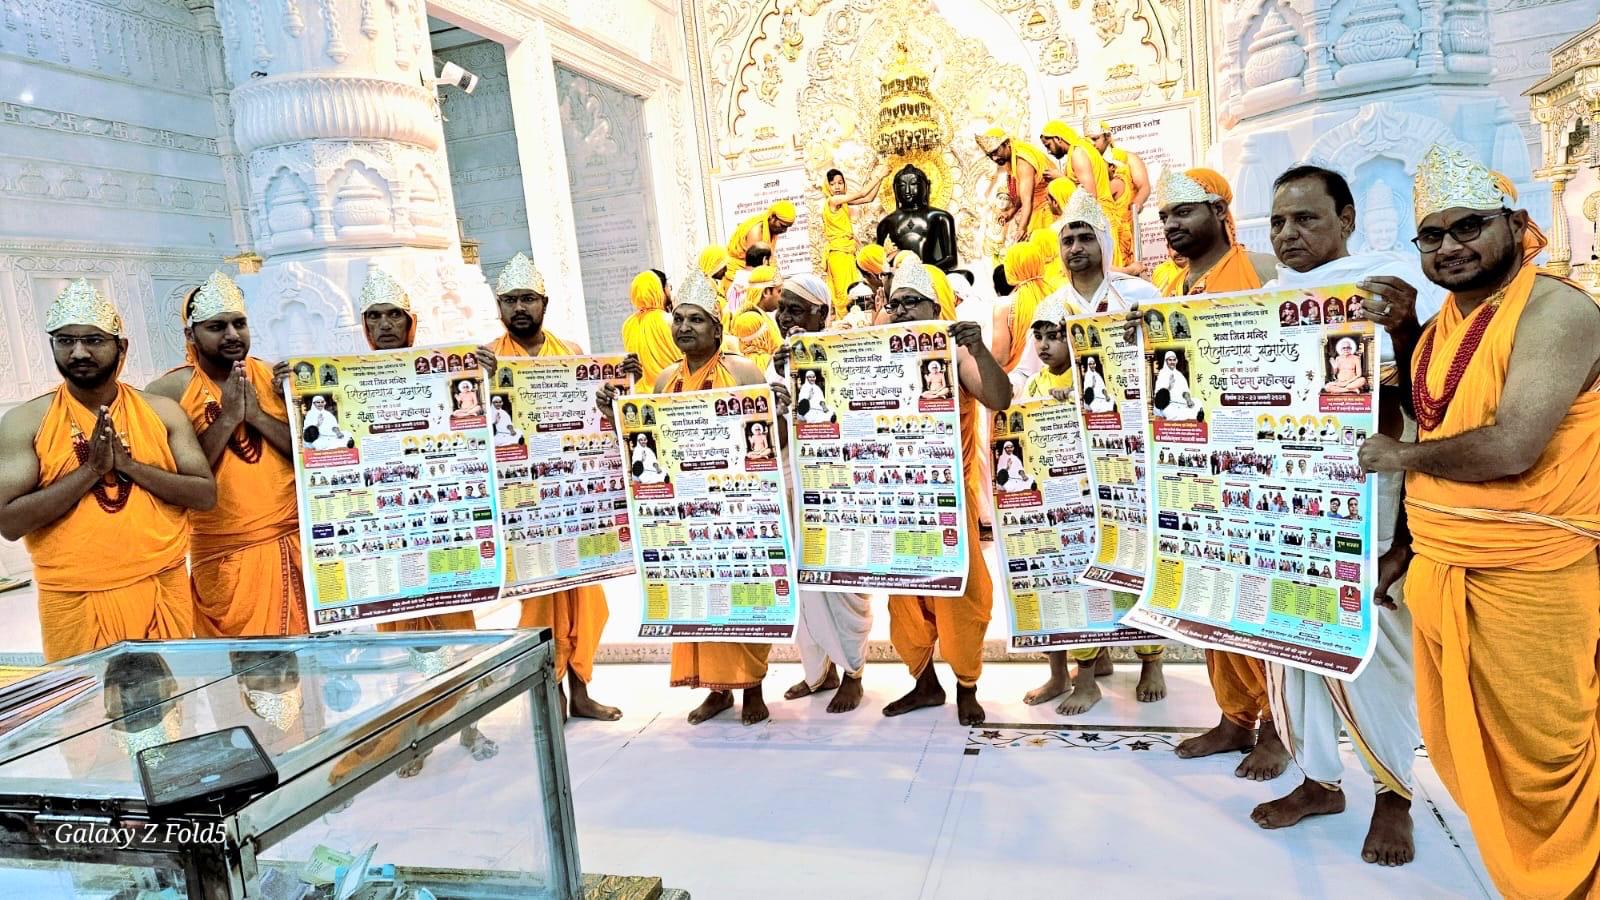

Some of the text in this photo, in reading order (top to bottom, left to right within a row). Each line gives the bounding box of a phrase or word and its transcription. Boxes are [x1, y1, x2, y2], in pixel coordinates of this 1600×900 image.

[1230, 330, 1245, 340] जिन
[1196, 339, 1300, 364] शिलान्यास समारोह
[1257, 374, 1296, 389] महोत्सव
